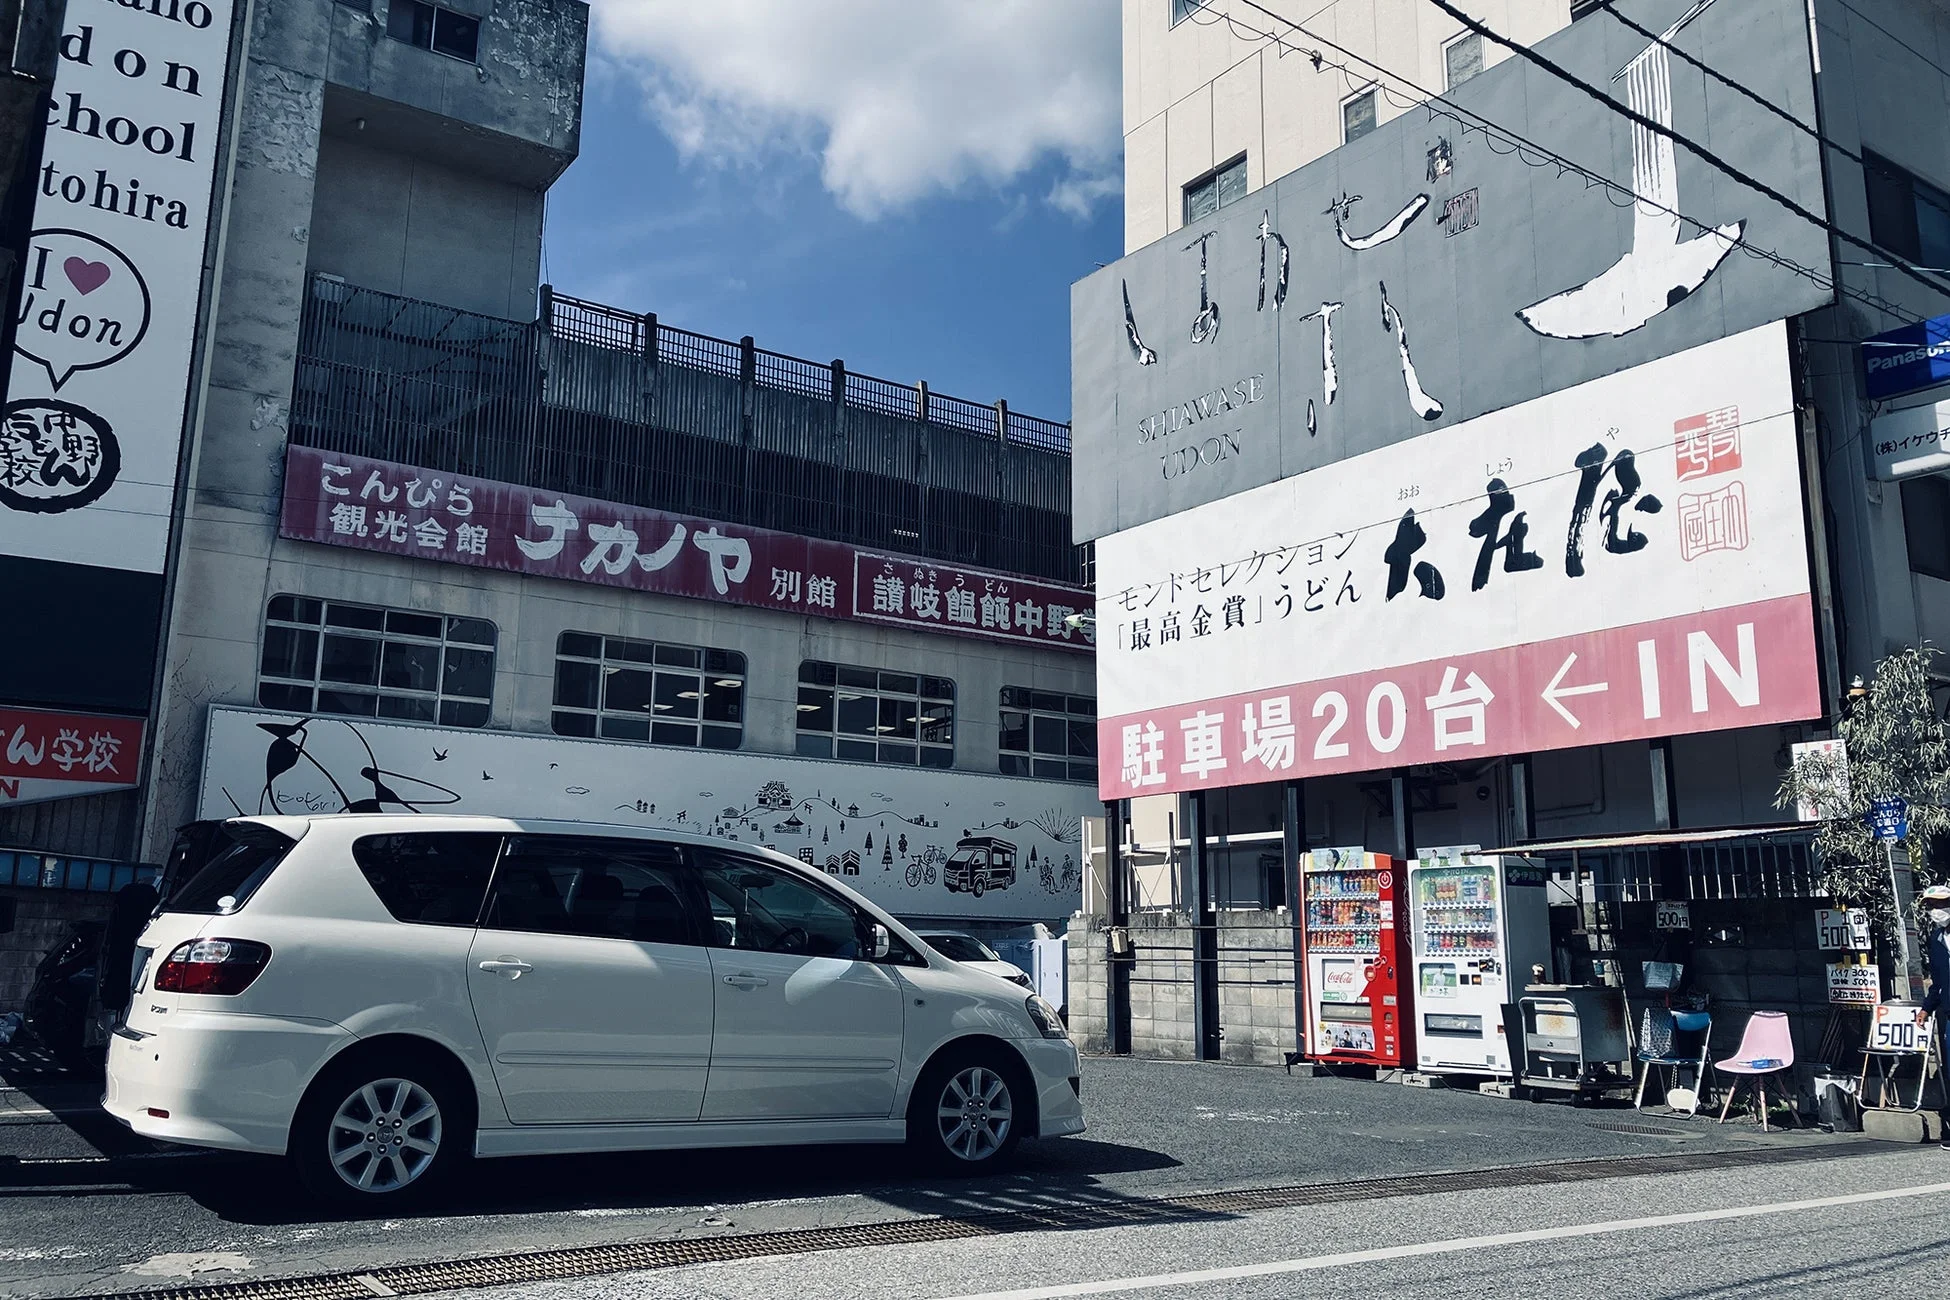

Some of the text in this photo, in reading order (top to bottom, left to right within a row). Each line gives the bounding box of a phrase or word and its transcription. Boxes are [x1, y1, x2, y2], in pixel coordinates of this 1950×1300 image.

[28, 245, 53, 290] I
[1138, 373, 1264, 445] SHIAWASE
[1605, 426, 1620, 440] や
[1160, 428, 1242, 480] UDON
[1486, 457, 1513, 477] しょう
[321, 462, 474, 517] こんぴら
[1397, 484, 1420, 501] おお
[329, 502, 489, 556] 観光会館
[514, 500, 752, 595] ナカノヤ
[770, 566, 837, 609] 別館
[1117, 530, 1361, 612] モンドセレクション
[1636, 621, 1762, 720] IN
[0, 724, 122, 775] ん学校
[1120, 665, 1496, 789] 駐車場20台
[1821, 911, 1829, 926] P
[1877, 1002, 1889, 1023] P
